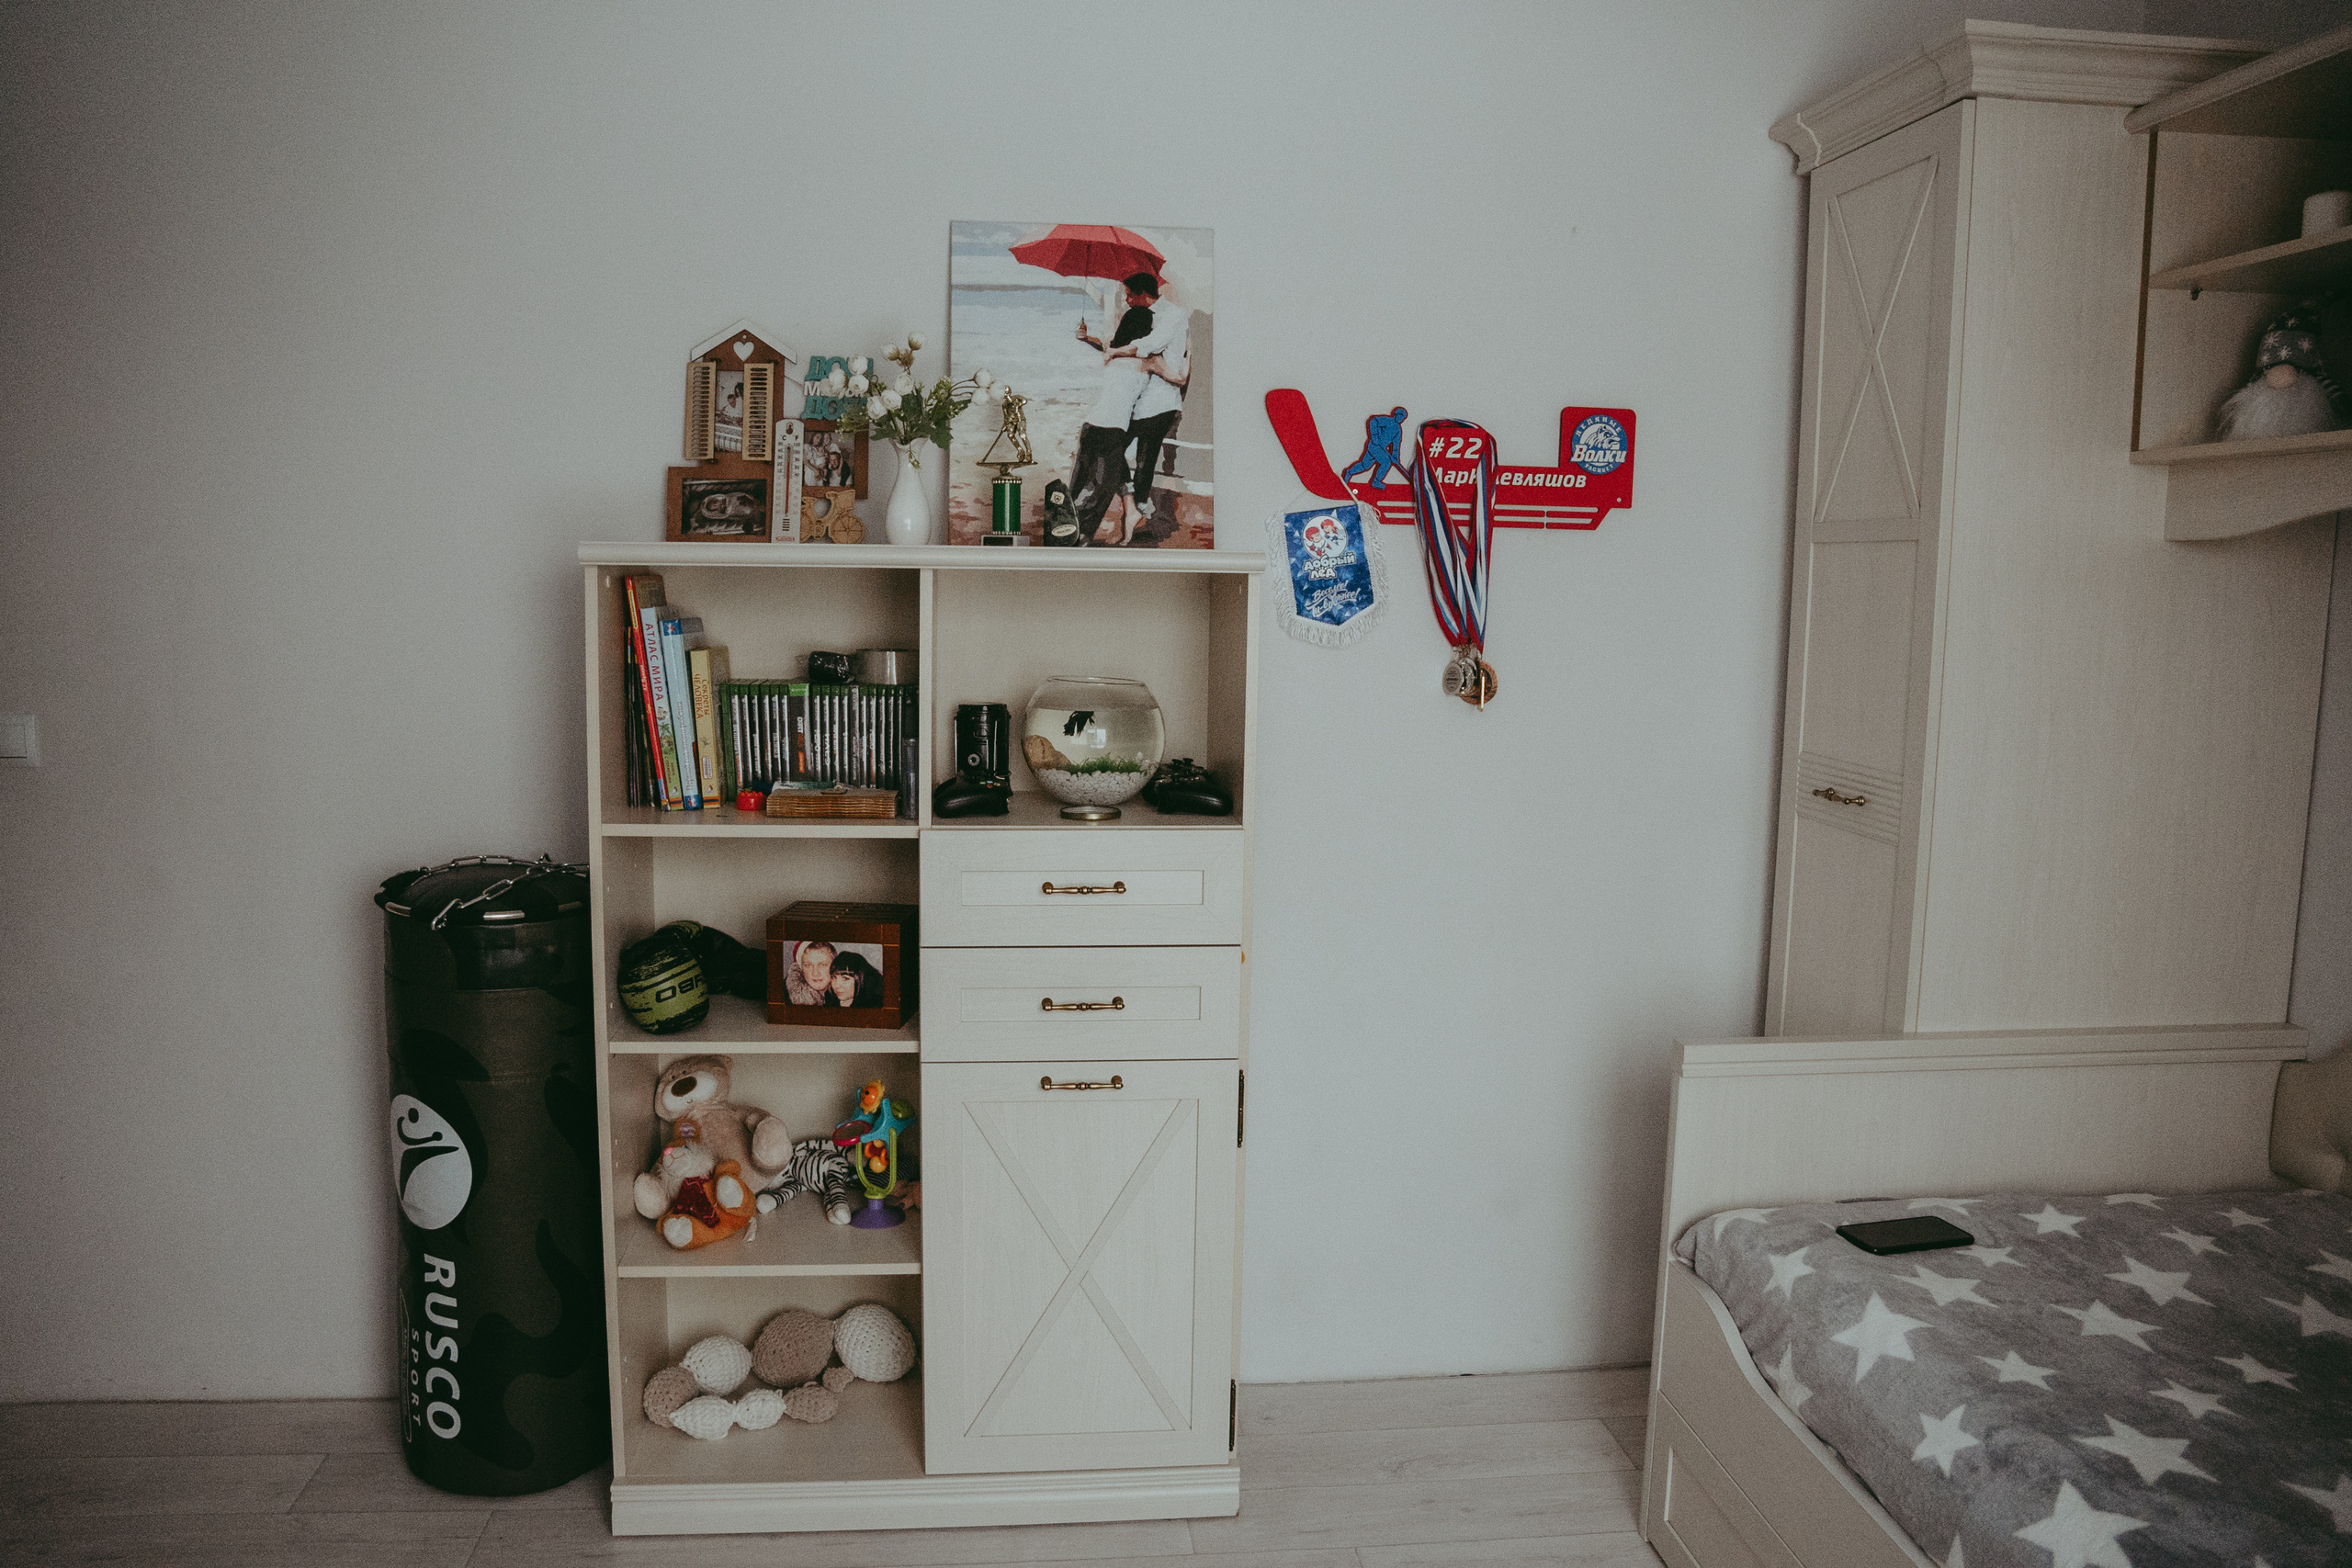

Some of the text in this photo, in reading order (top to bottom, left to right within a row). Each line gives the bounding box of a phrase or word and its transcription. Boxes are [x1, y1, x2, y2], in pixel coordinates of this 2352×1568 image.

[1430, 437, 1482, 458] #22
[1570, 445, 1627, 462] Волки
[1496, 471, 1587, 488] евляшов
[645, 623, 663, 700] АТЛАС МИРА
[694, 673, 703, 718] ЧЕЛОВЕКА
[424, 1253, 461, 1438] RUSCO
[411, 1328, 421, 1426] SPORT
